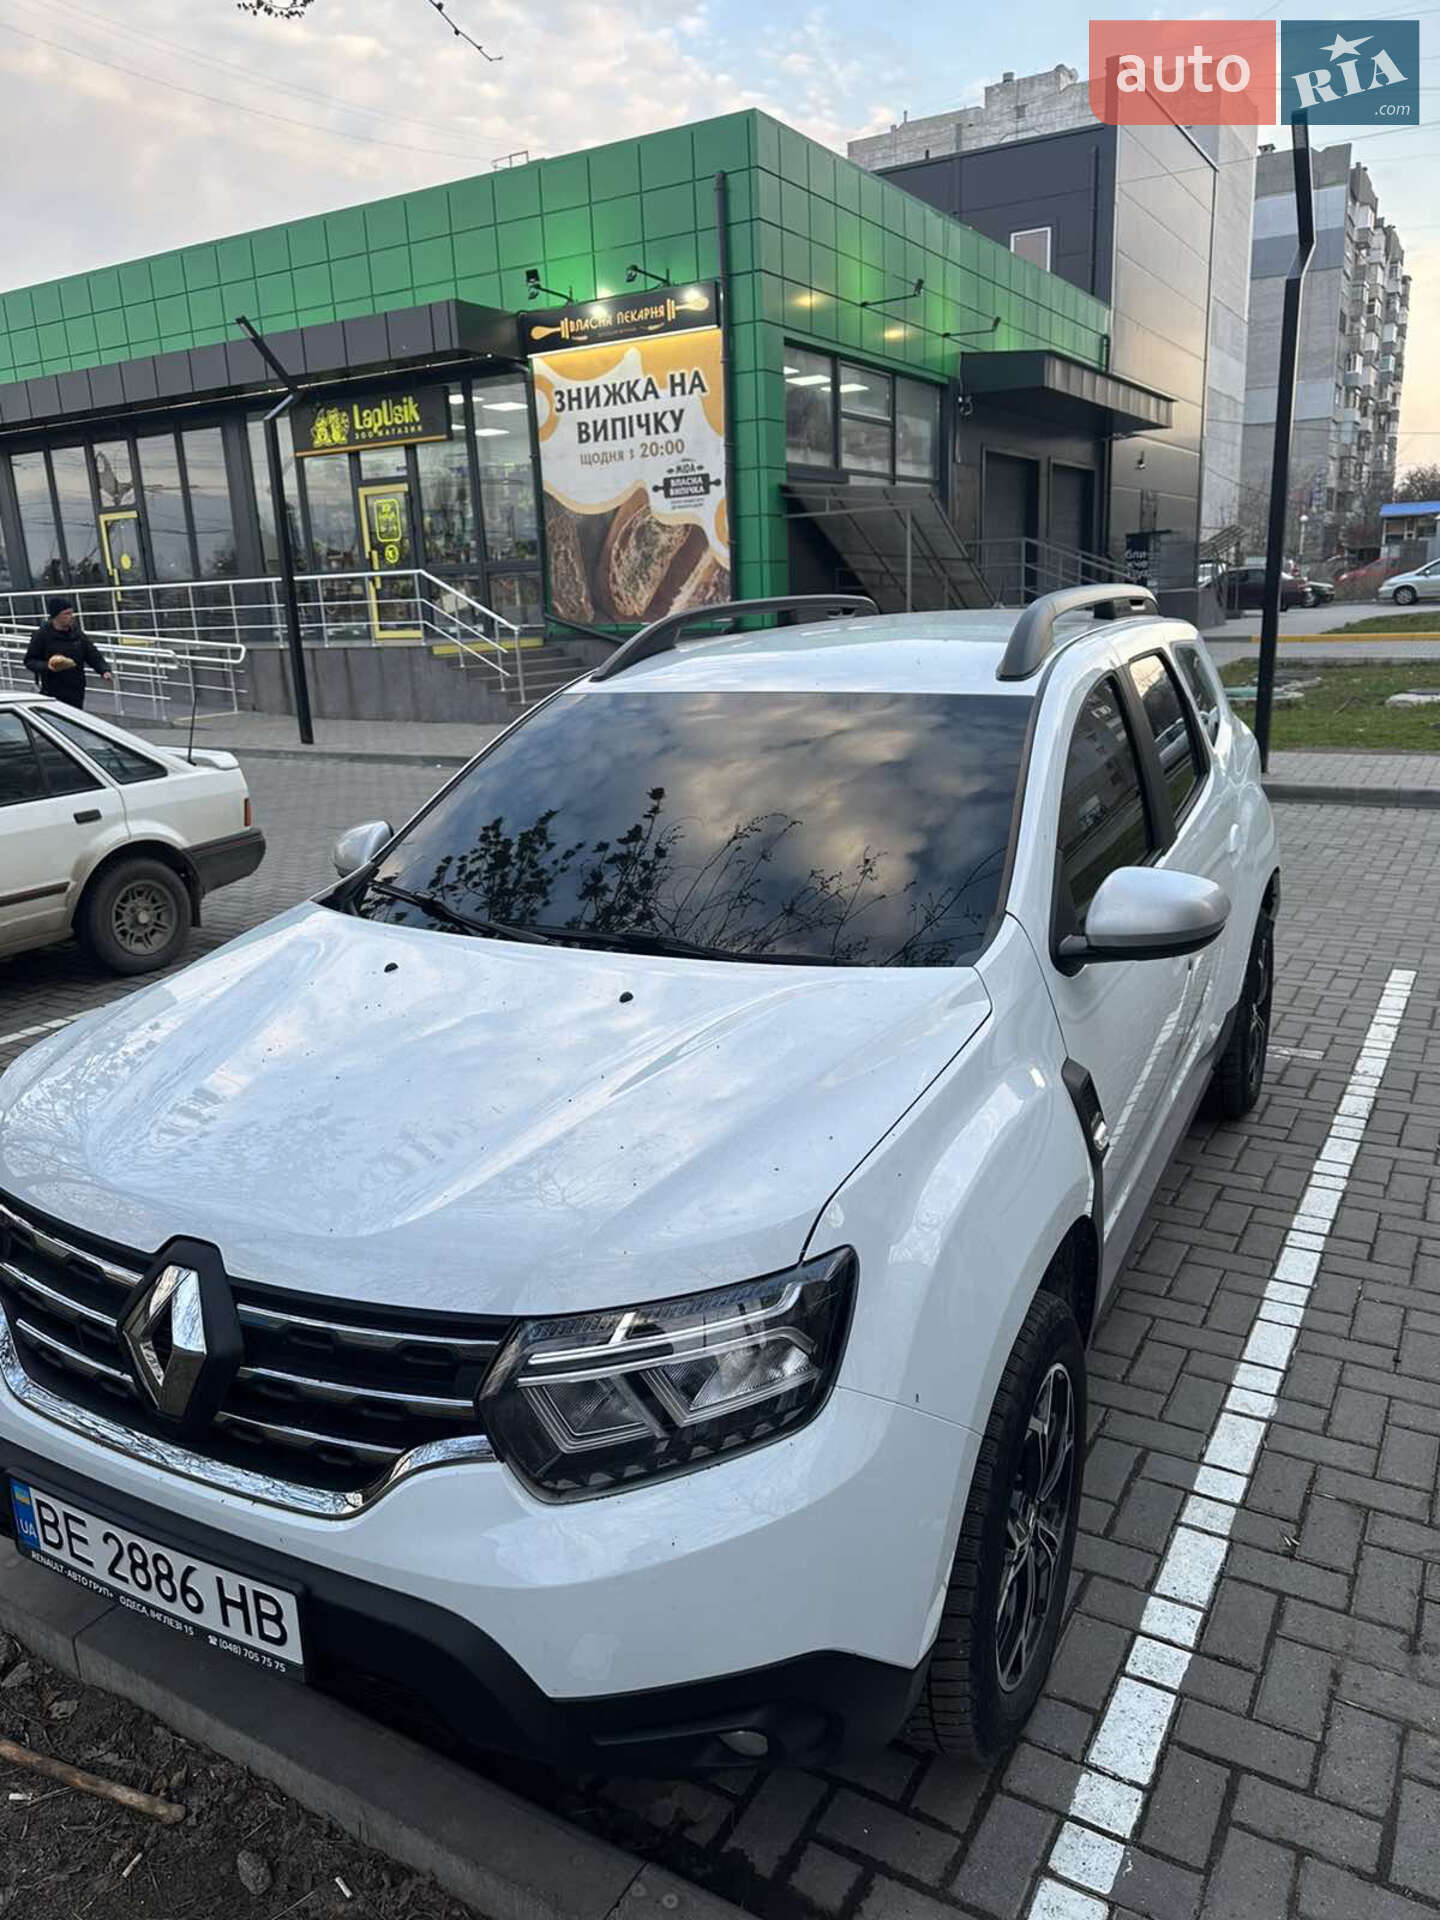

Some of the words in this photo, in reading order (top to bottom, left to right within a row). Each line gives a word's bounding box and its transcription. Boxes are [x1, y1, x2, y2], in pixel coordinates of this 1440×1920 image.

[569, 316, 613, 333] ВЛАСНА
[616, 305, 664, 324] ПЕКАРНЯ
[554, 377, 660, 412] ЗНИЖКА
[669, 370, 707, 397] НА
[353, 396, 420, 433] LapUsik
[577, 408, 685, 444] ВИПІЧКУ
[640, 439, 685, 458] 20:00
[19, 1518, 38, 1539] UA
[35, 1498, 94, 1568] BE
[102, 1531, 205, 1614] 2886
[216, 1576, 288, 1646] HB
[243, 1648, 260, 1662] 705
[261, 1655, 272, 1668] 75
[274, 1661, 286, 1673] 75
